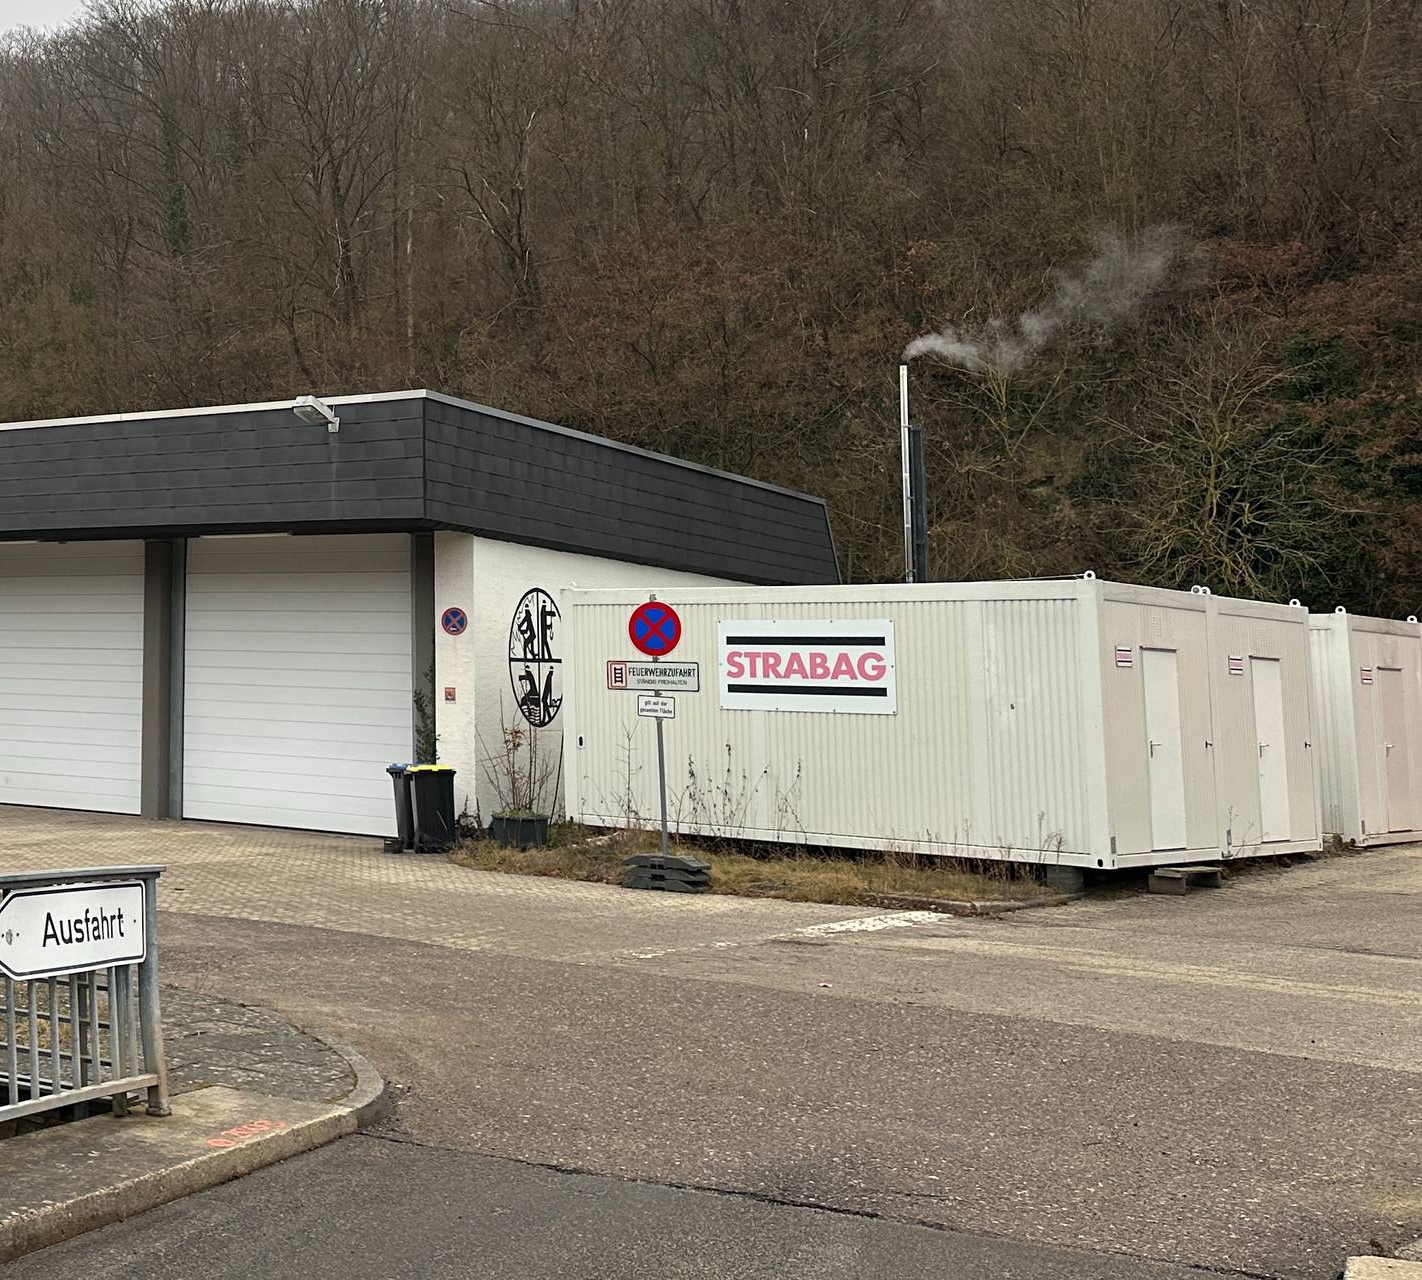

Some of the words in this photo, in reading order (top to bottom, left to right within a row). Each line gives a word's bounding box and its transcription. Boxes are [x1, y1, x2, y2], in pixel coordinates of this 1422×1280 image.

[628, 667, 695, 677] FEUERWEHRZUFAHRT
[726, 651, 887, 681] STRABAG
[42, 907, 125, 948] Ausfahrt
